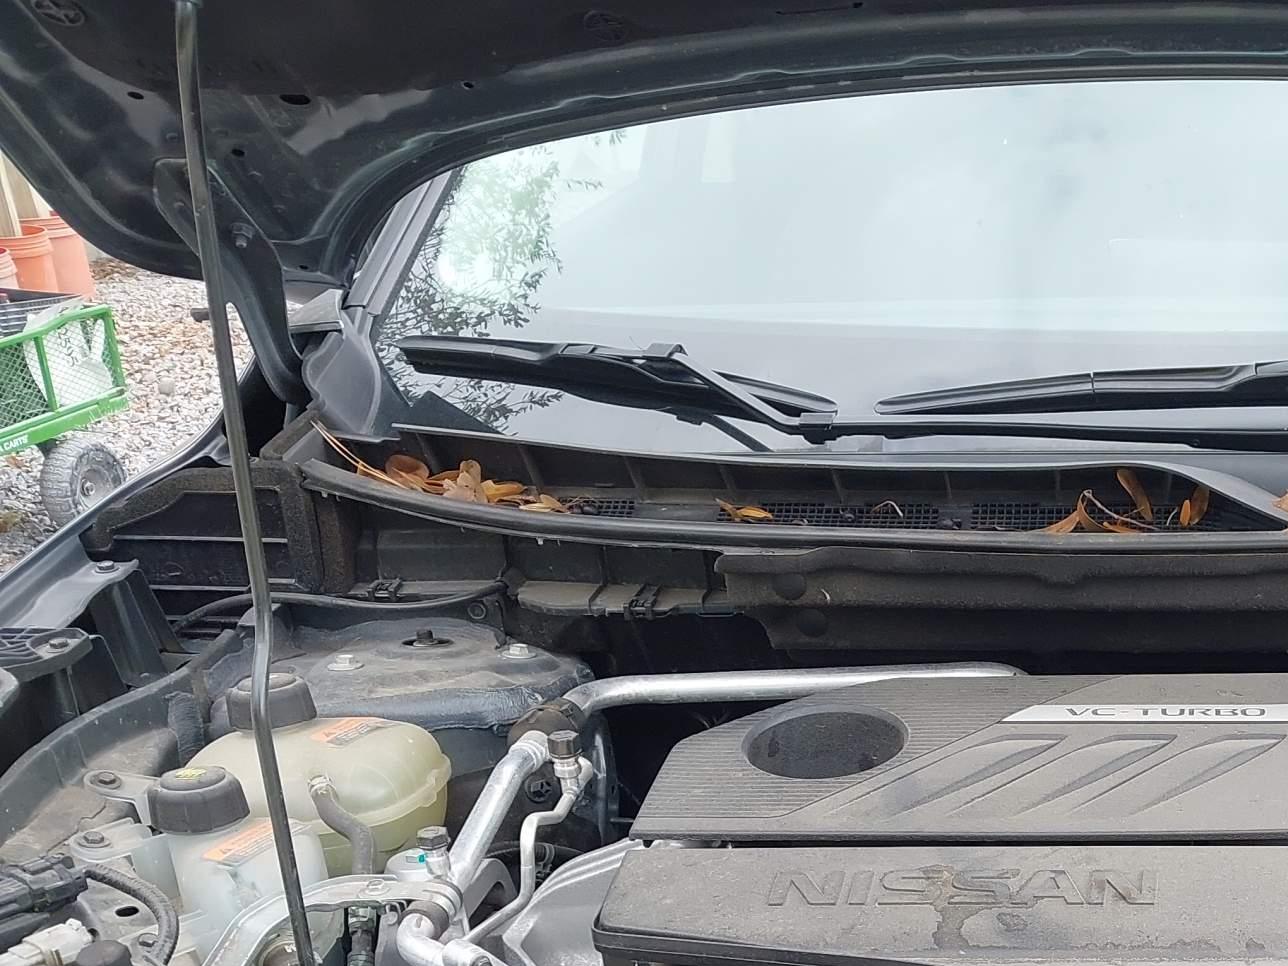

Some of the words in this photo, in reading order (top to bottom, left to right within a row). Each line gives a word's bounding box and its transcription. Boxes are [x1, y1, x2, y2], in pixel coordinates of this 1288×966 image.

[4, 434, 28, 451] CARTS
[1065, 707, 1266, 717] VC-TURBO
[767, 869, 1156, 907] NISSAN
